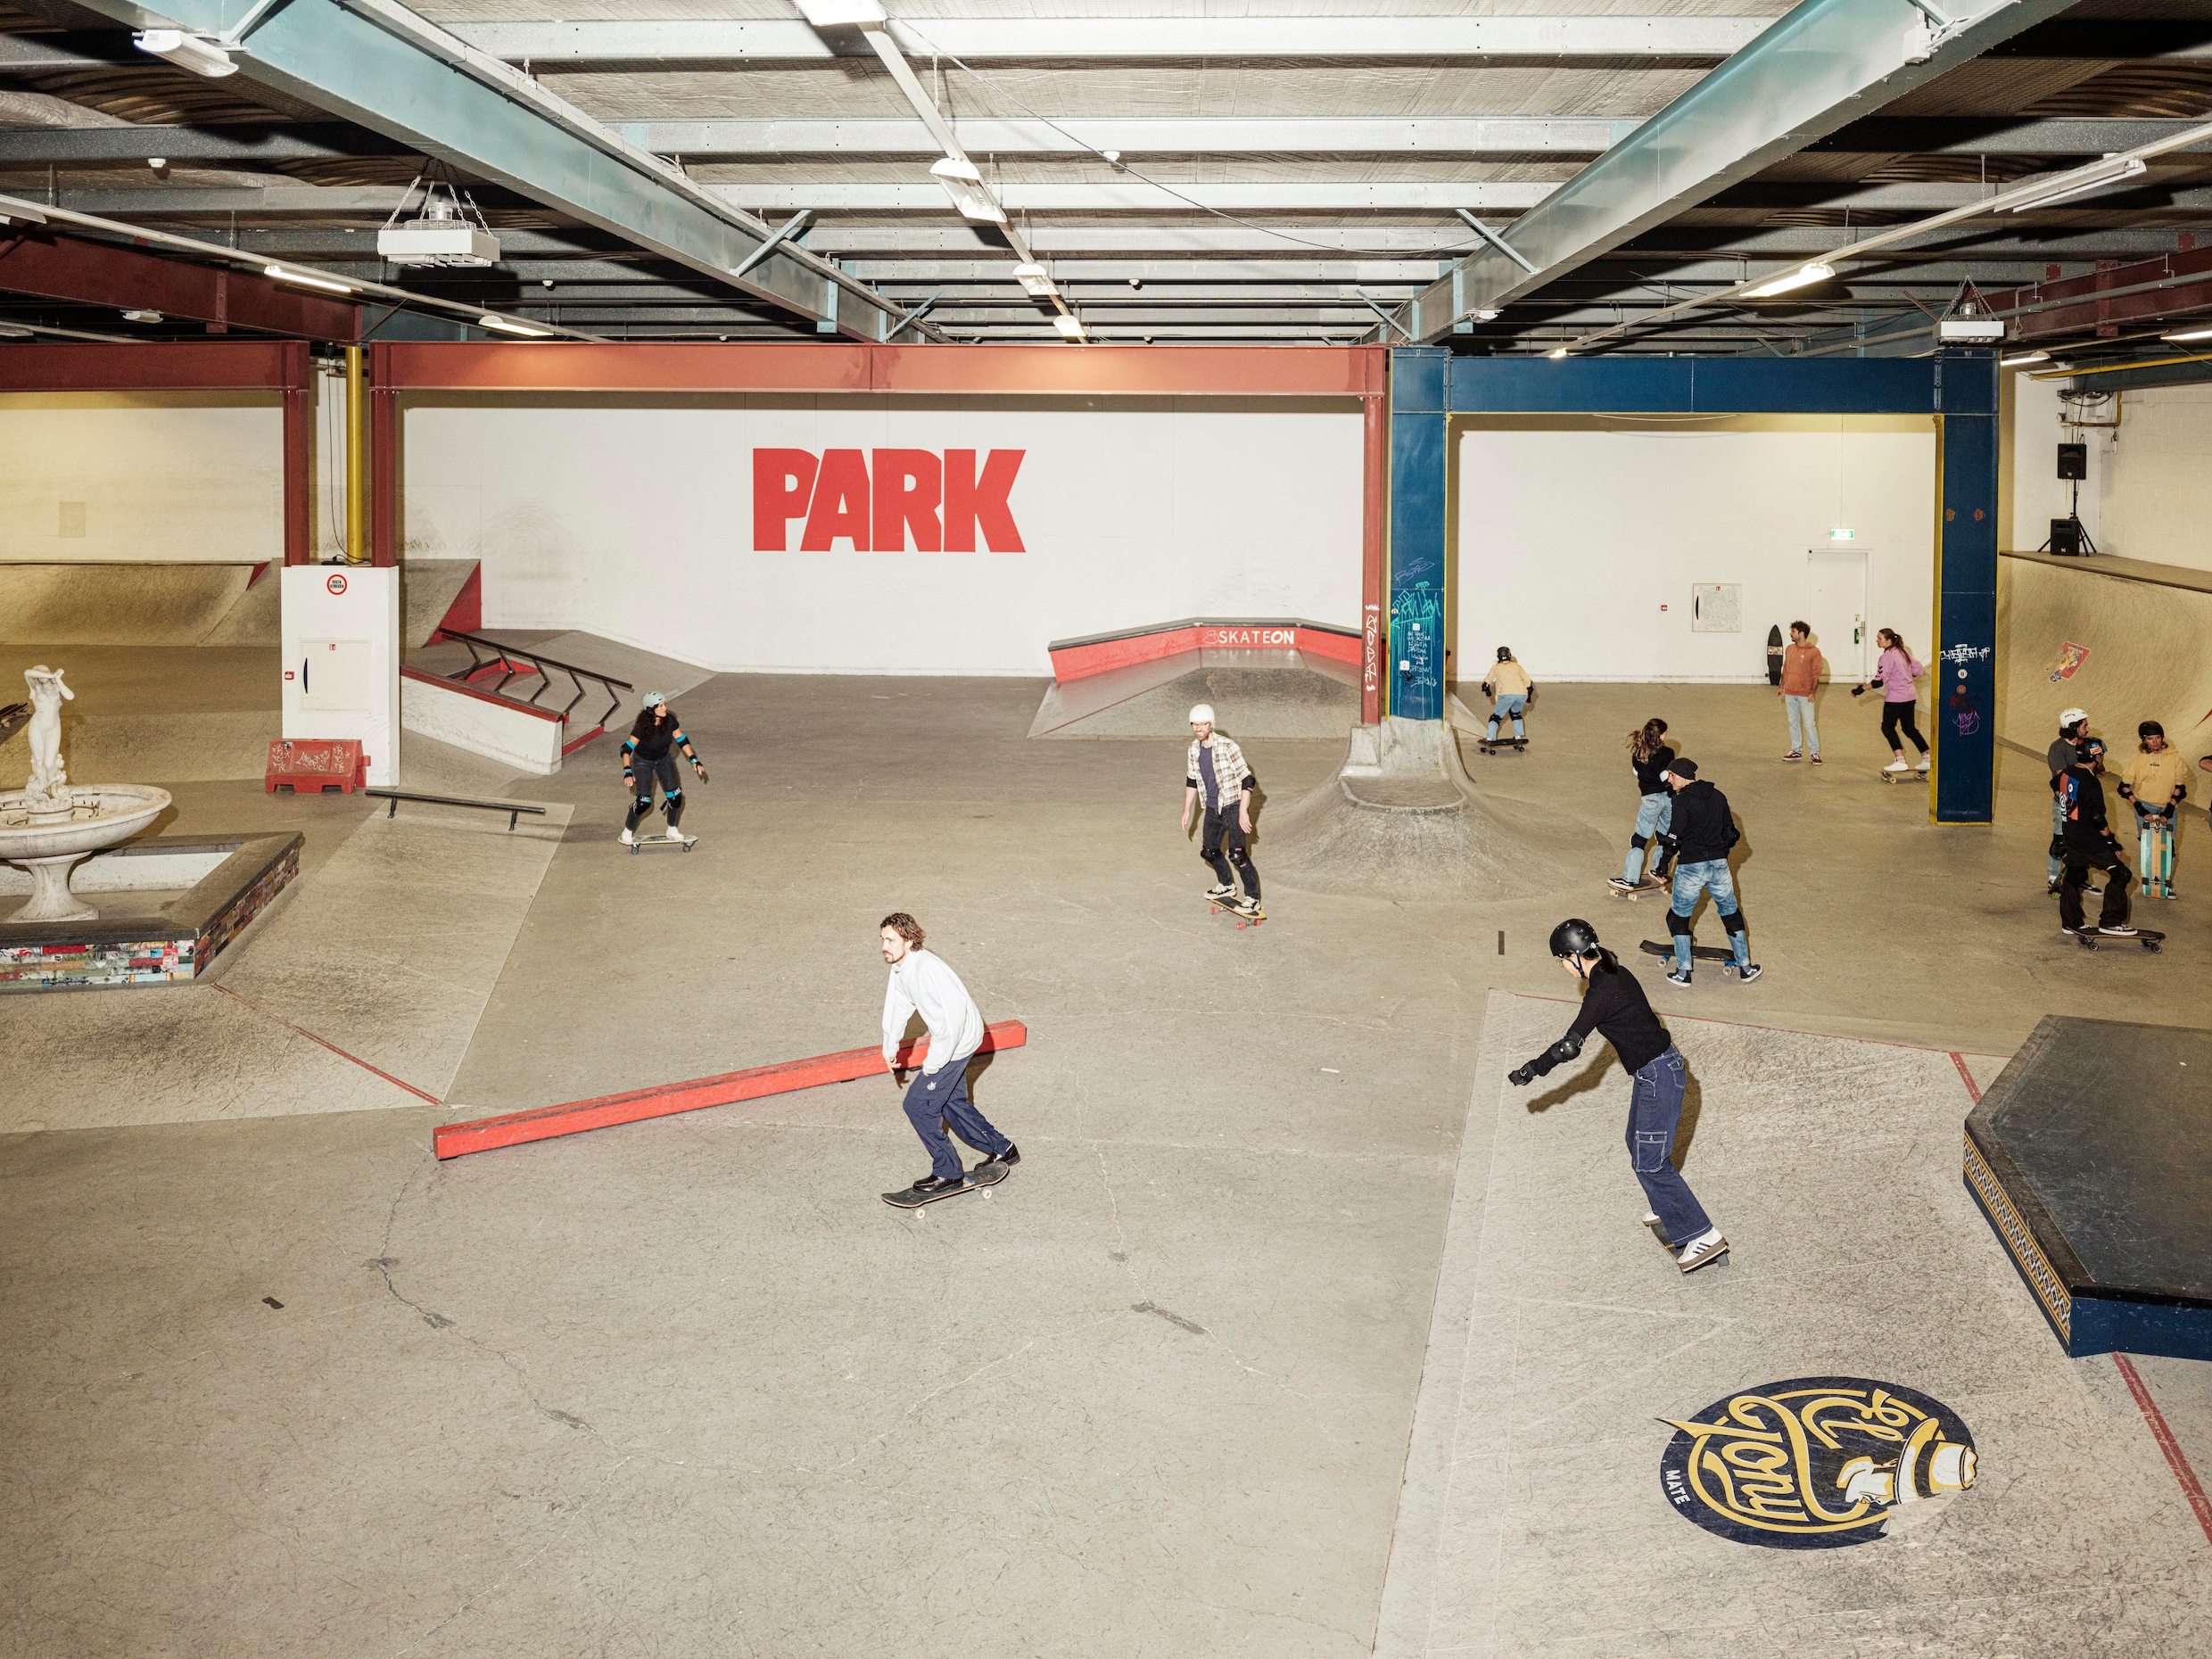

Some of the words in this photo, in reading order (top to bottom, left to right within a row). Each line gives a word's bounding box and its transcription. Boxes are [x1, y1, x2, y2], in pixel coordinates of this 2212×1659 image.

[753, 448, 1027, 553] PARK
[1655, 1395, 1871, 1523] Tony
[1800, 1388, 1911, 1450] El
[1665, 1469, 1691, 1505] MATE
